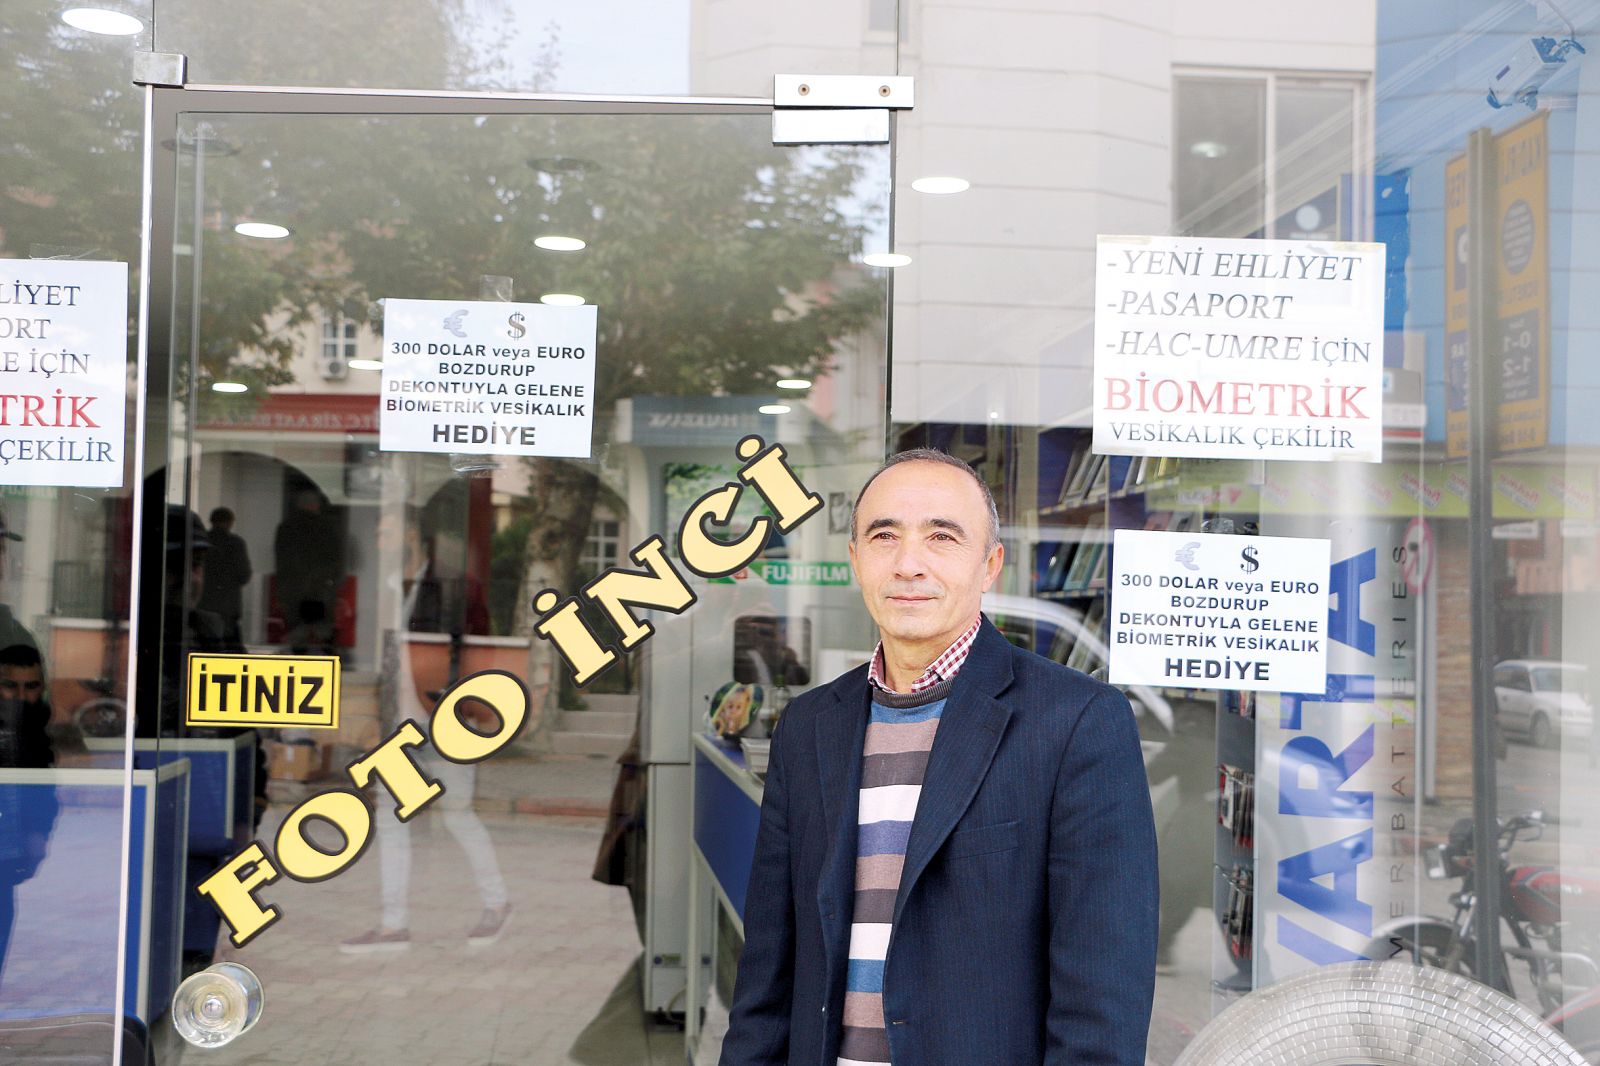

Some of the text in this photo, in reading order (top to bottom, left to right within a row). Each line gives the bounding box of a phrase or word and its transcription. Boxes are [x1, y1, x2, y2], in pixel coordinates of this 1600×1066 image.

[1211, 249, 1362, 281] EHLİYET
[29, 347, 91, 379] İÇİN
[391, 342, 585, 361] 300 DOLAR veya EURO
[1311, 336, 1372, 368] İÇİN
[439, 363, 535, 377] BOZDURUP
[389, 380, 585, 398] DEKONTUYLA GELENE
[1103, 371, 1370, 419] BİOMETRİK
[387, 397, 585, 417] BİOMETRİK VESİKALIK
[433, 421, 536, 446] HEDİYE
[1109, 420, 1355, 450] VESİKALIK ÇEKİLİR
[0, 436, 115, 466] ÇEKİLİR
[762, 563, 849, 582] FUJIFILM
[1121, 574, 1319, 595] 300 DOLAR veya EURO
[1171, 595, 1269, 611] BOZDURUP
[1119, 612, 1318, 633] DEKONTUYLA GELENE
[1117, 629, 1319, 653] BİOMETRİK VESİKALIK
[1164, 656, 1270, 681] HEDİYE
[196, 434, 825, 948] FOTO İNCİ
[199, 663, 324, 715] İTİNİZ
